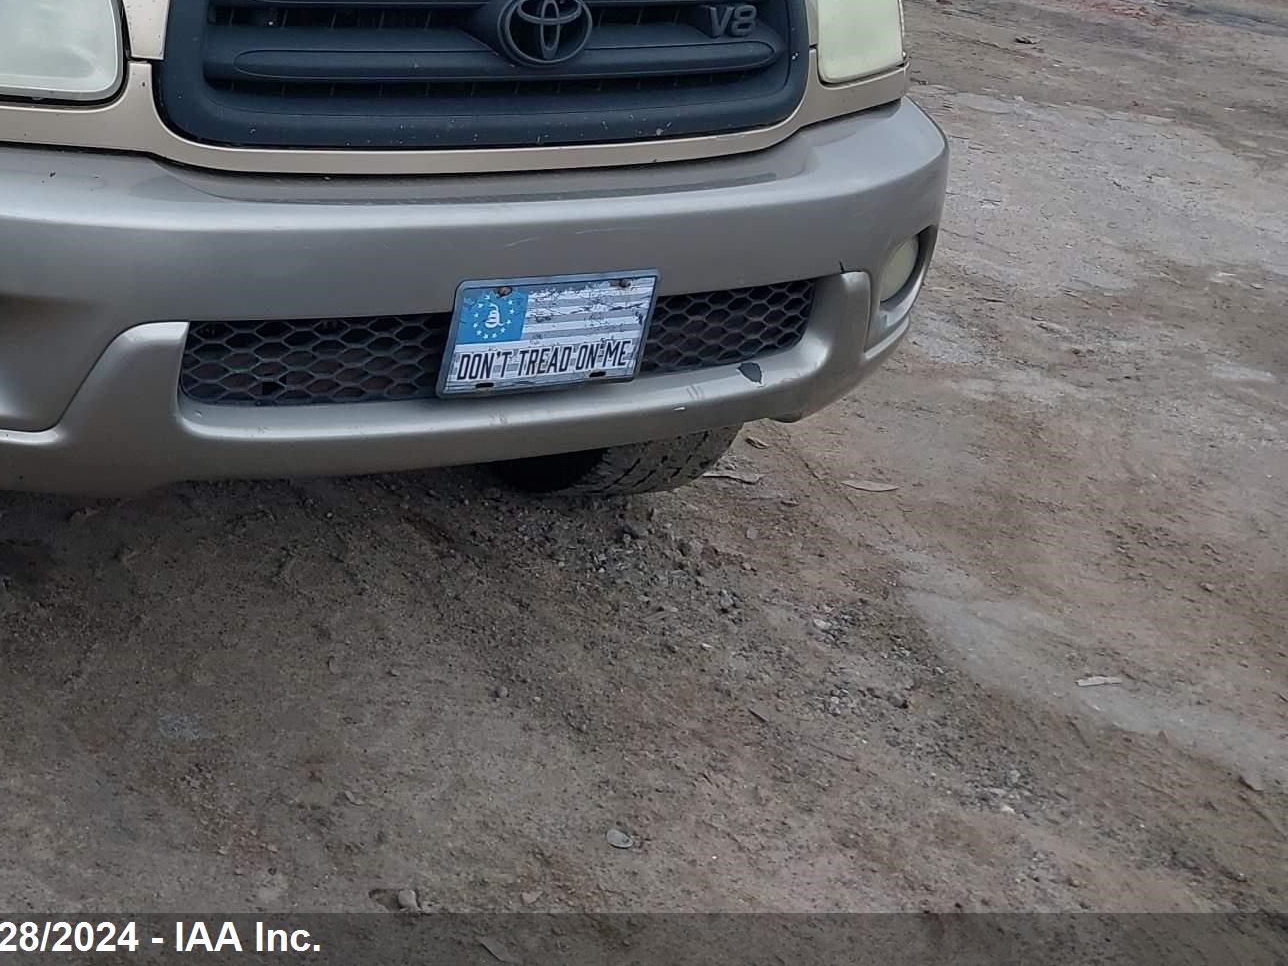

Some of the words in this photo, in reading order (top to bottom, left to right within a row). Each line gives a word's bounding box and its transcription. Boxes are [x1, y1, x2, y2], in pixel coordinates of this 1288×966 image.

[709, 4, 757, 37] V8
[457, 351, 512, 380] DON'T
[518, 346, 572, 376] TREAD
[576, 344, 600, 370] ON
[602, 340, 631, 367] ME
